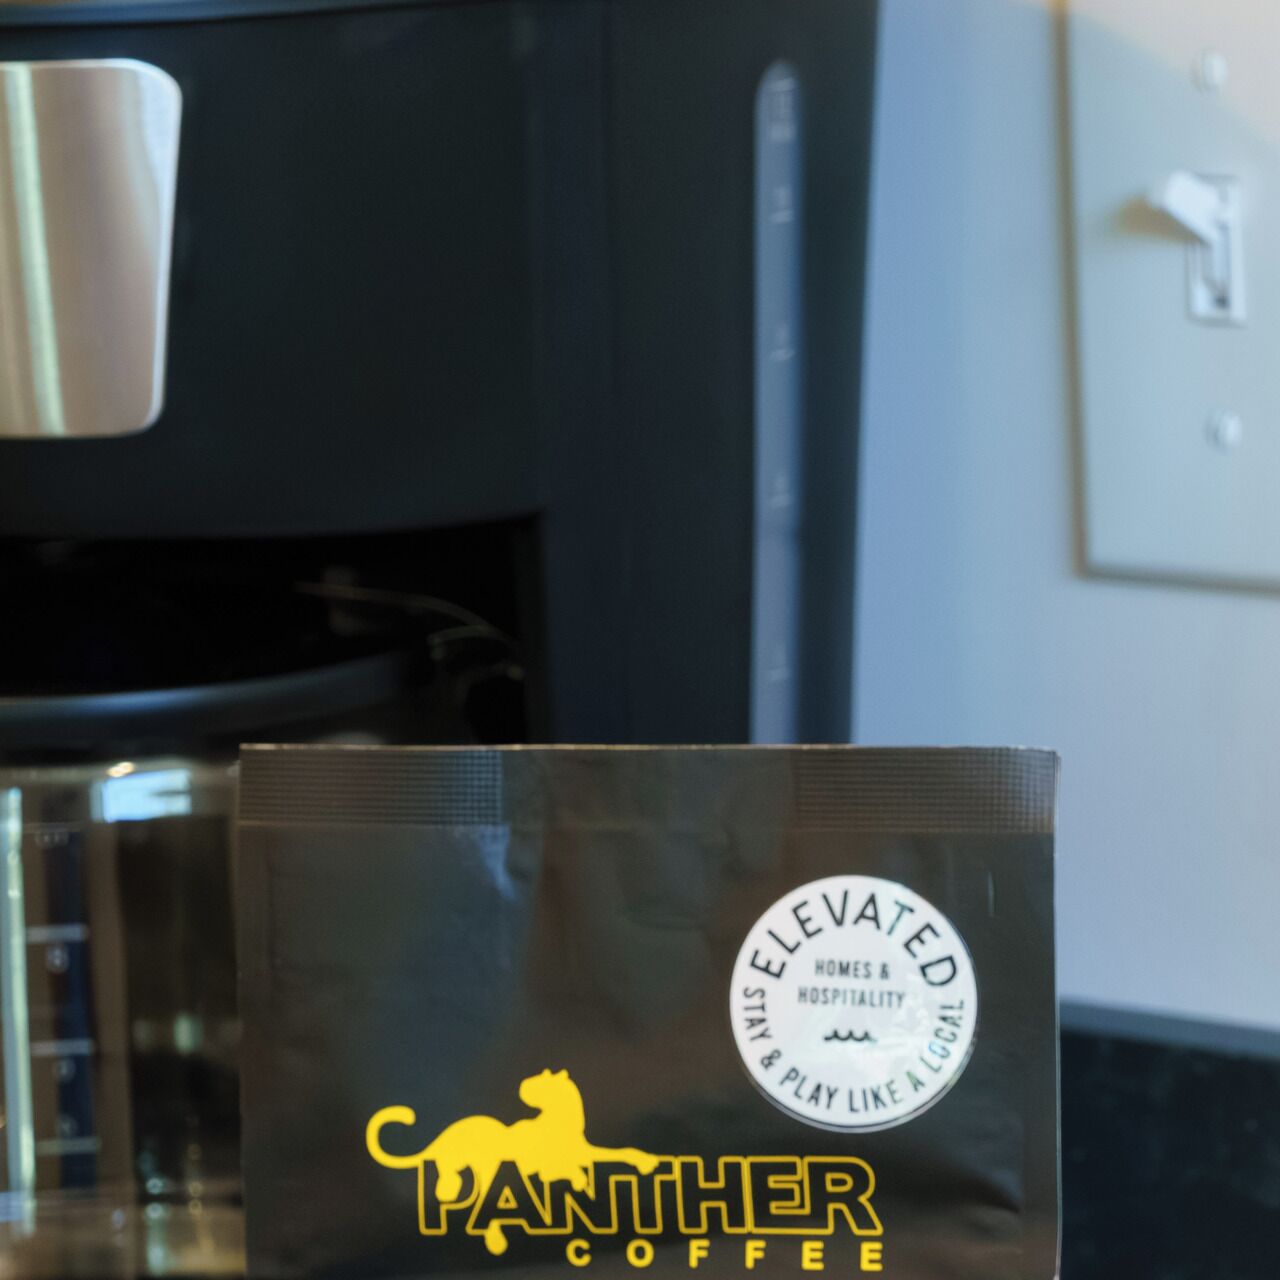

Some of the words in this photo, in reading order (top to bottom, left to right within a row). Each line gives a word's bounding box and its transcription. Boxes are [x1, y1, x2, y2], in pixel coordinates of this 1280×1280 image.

[750, 890, 957, 988] ELEVATED
[815, 959, 871, 979] HOMES
[880, 961, 890, 979] &
[797, 987, 906, 1009] HOSPITALITY
[743, 987, 773, 1043] STAY
[760, 1049, 781, 1071] &
[779, 1067, 839, 1111] PLAY
[848, 1080, 903, 1113] LIKE
[905, 1070, 926, 1092] A
[919, 999, 964, 1074] LOCAL
[419, 1155, 884, 1236] PANTHER
[566, 1238, 883, 1271] COFFEE
